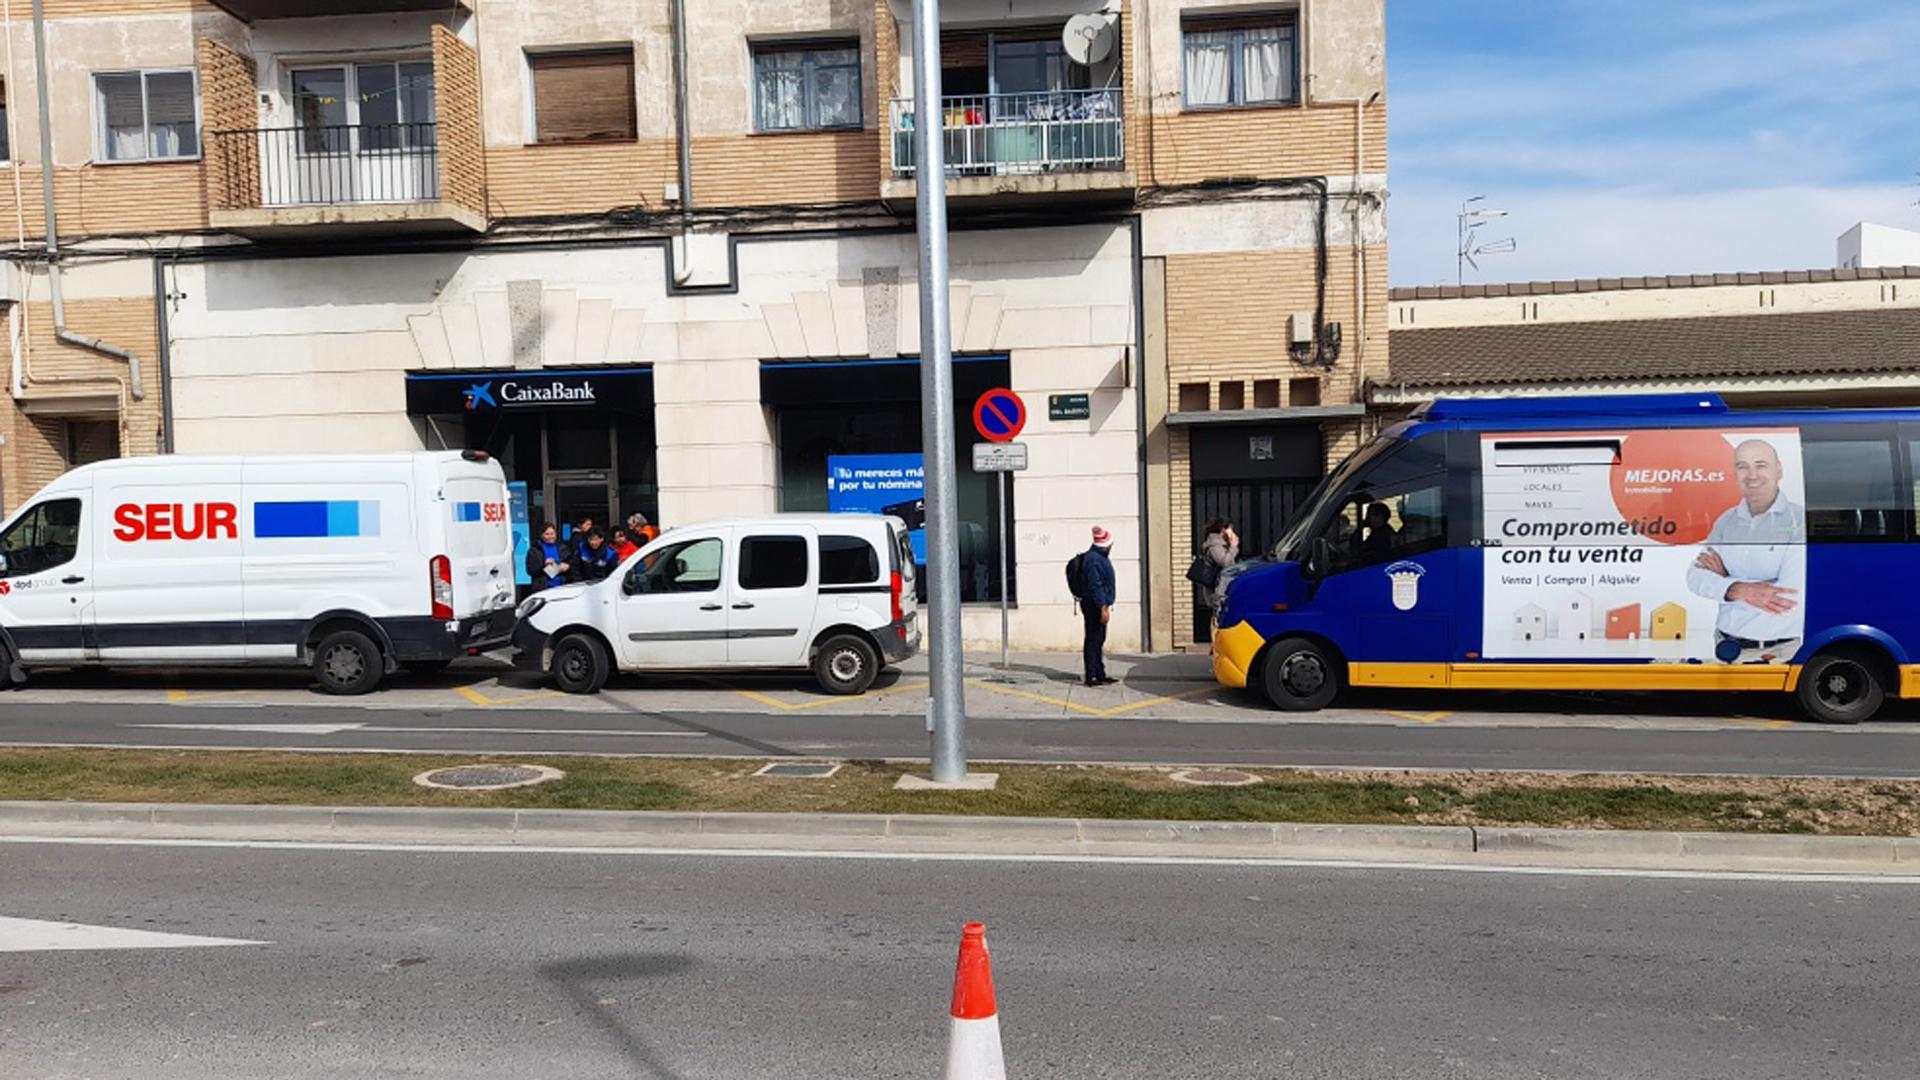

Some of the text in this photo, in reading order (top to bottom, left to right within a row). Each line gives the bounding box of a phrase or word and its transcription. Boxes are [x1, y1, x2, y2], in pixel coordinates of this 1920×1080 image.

[500, 381, 596, 401] CaixaBank
[855, 469, 903, 478] mereces
[905, 466, 925, 477] má
[1624, 468, 1726, 484] MEJORAS.es
[839, 479, 923, 493] por tu nómina
[1523, 483, 1562, 491] LOCALES
[1525, 501, 1553, 509] NAVES
[113, 502, 238, 542] SEUR
[1501, 516, 1677, 540] Comprometido
[1501, 545, 1644, 564] con tu venta
[1501, 573, 1641, 588] Venta Compra Alquiler
